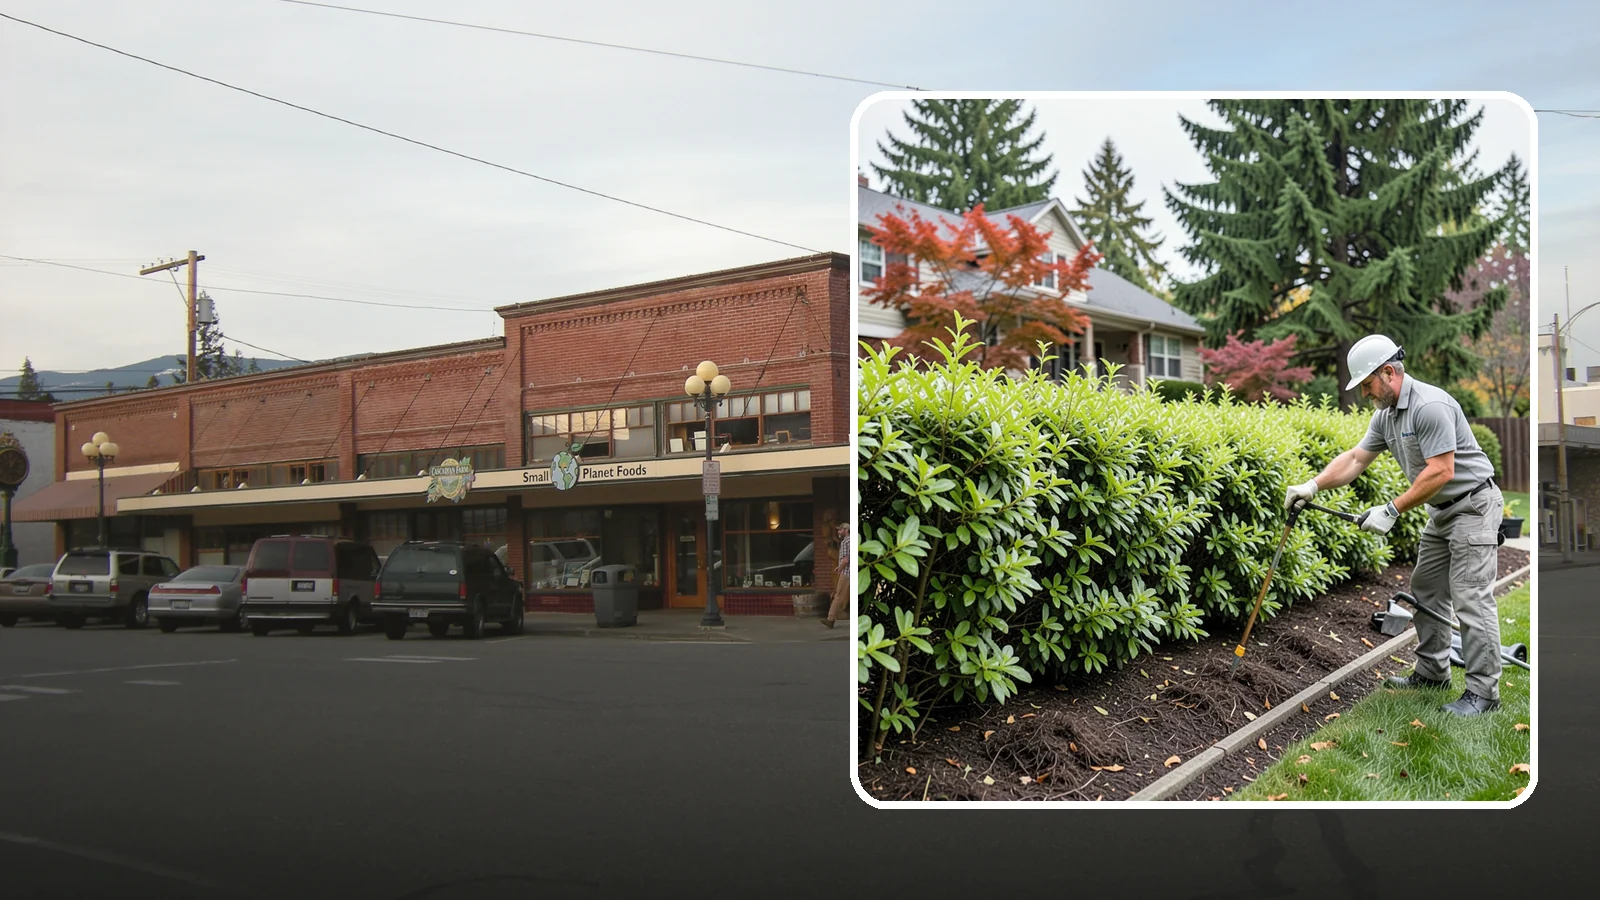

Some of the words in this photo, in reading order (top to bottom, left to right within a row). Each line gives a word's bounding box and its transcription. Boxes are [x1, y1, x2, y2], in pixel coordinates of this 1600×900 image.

[523, 471, 549, 483] Small
[583, 467, 614, 479] Planet
[616, 464, 647, 477] Foods
